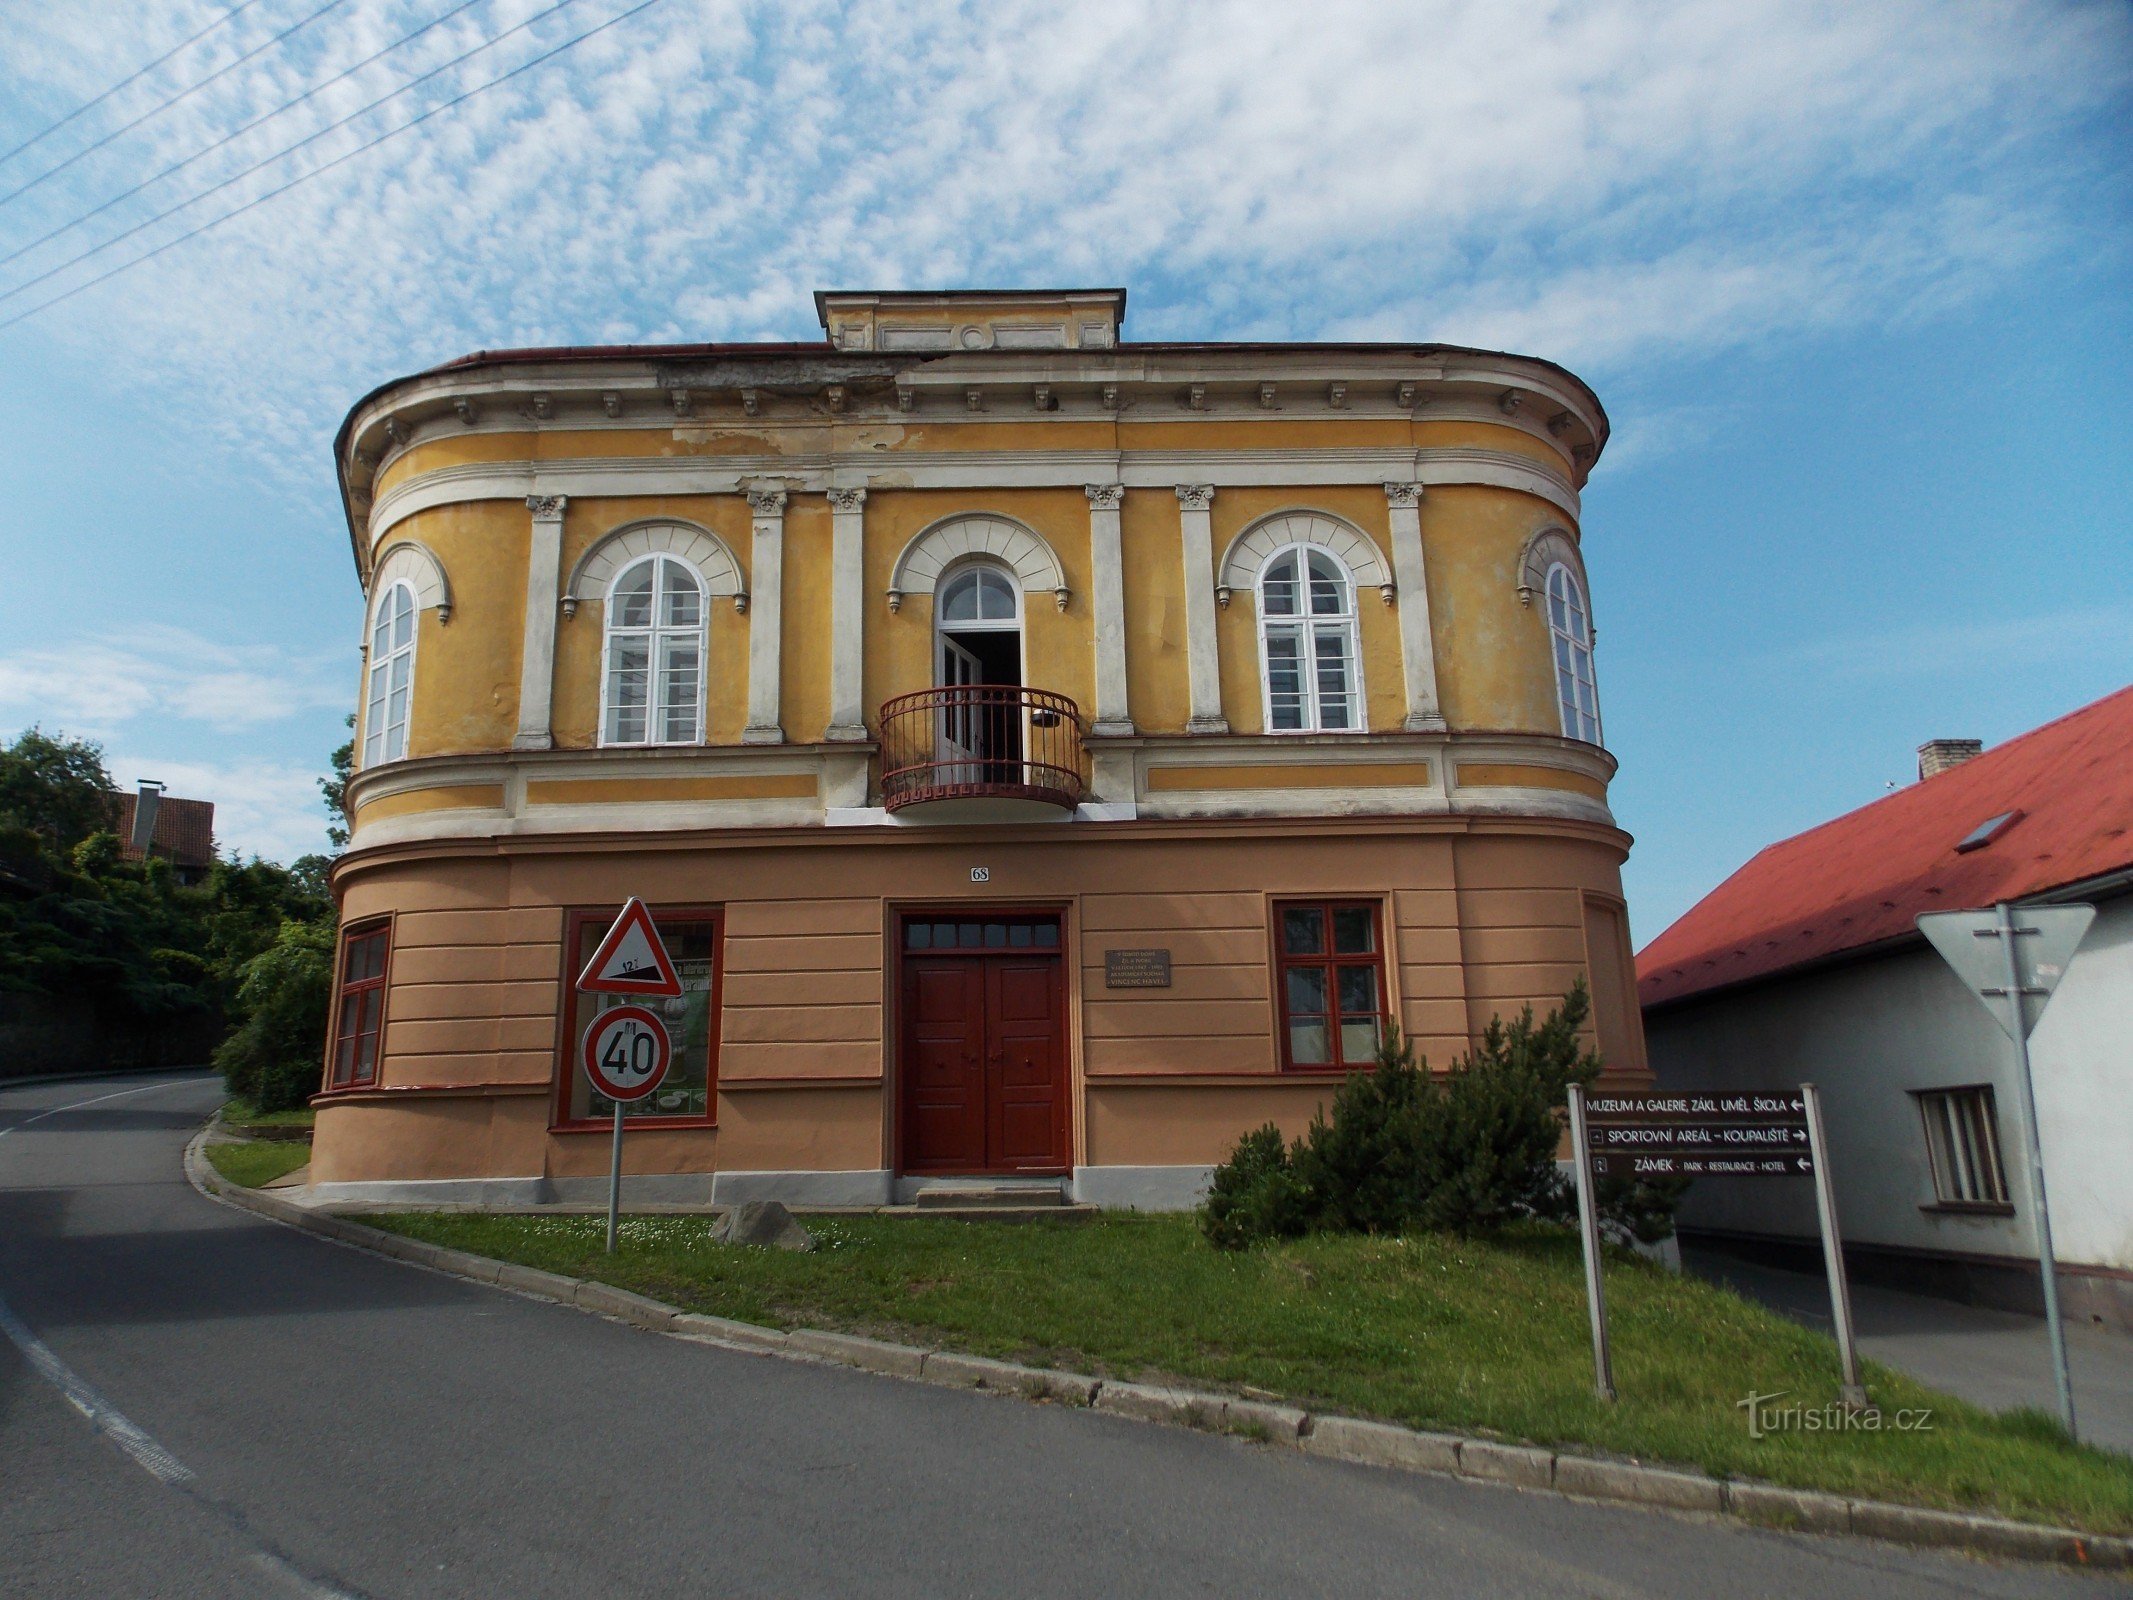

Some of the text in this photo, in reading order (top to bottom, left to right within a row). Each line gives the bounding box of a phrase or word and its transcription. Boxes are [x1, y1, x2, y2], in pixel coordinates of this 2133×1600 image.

[973, 868, 988, 880] 68
[601, 1031, 655, 1075] 40
[1586, 1099, 1633, 1112] MUZEUM
[1635, 1099, 1645, 1112] A
[1646, 1099, 1689, 1113] GALERIE,
[1691, 1097, 1718, 1112] ZÁKL.
[1753, 1096, 1787, 1112] ŠKOLA
[1608, 1128, 1672, 1143] SPORTOVNÍ
[1676, 1128, 1713, 1143] AREÁL
[1723, 1128, 1789, 1143] KOUPALIŠTĚ
[1634, 1155, 1674, 1171] ZÁMEK
[1683, 1161, 1703, 1171] PARK
[1708, 1161, 1756, 1171] RESTAURACE
[1761, 1161, 1786, 1171] HOTEL
